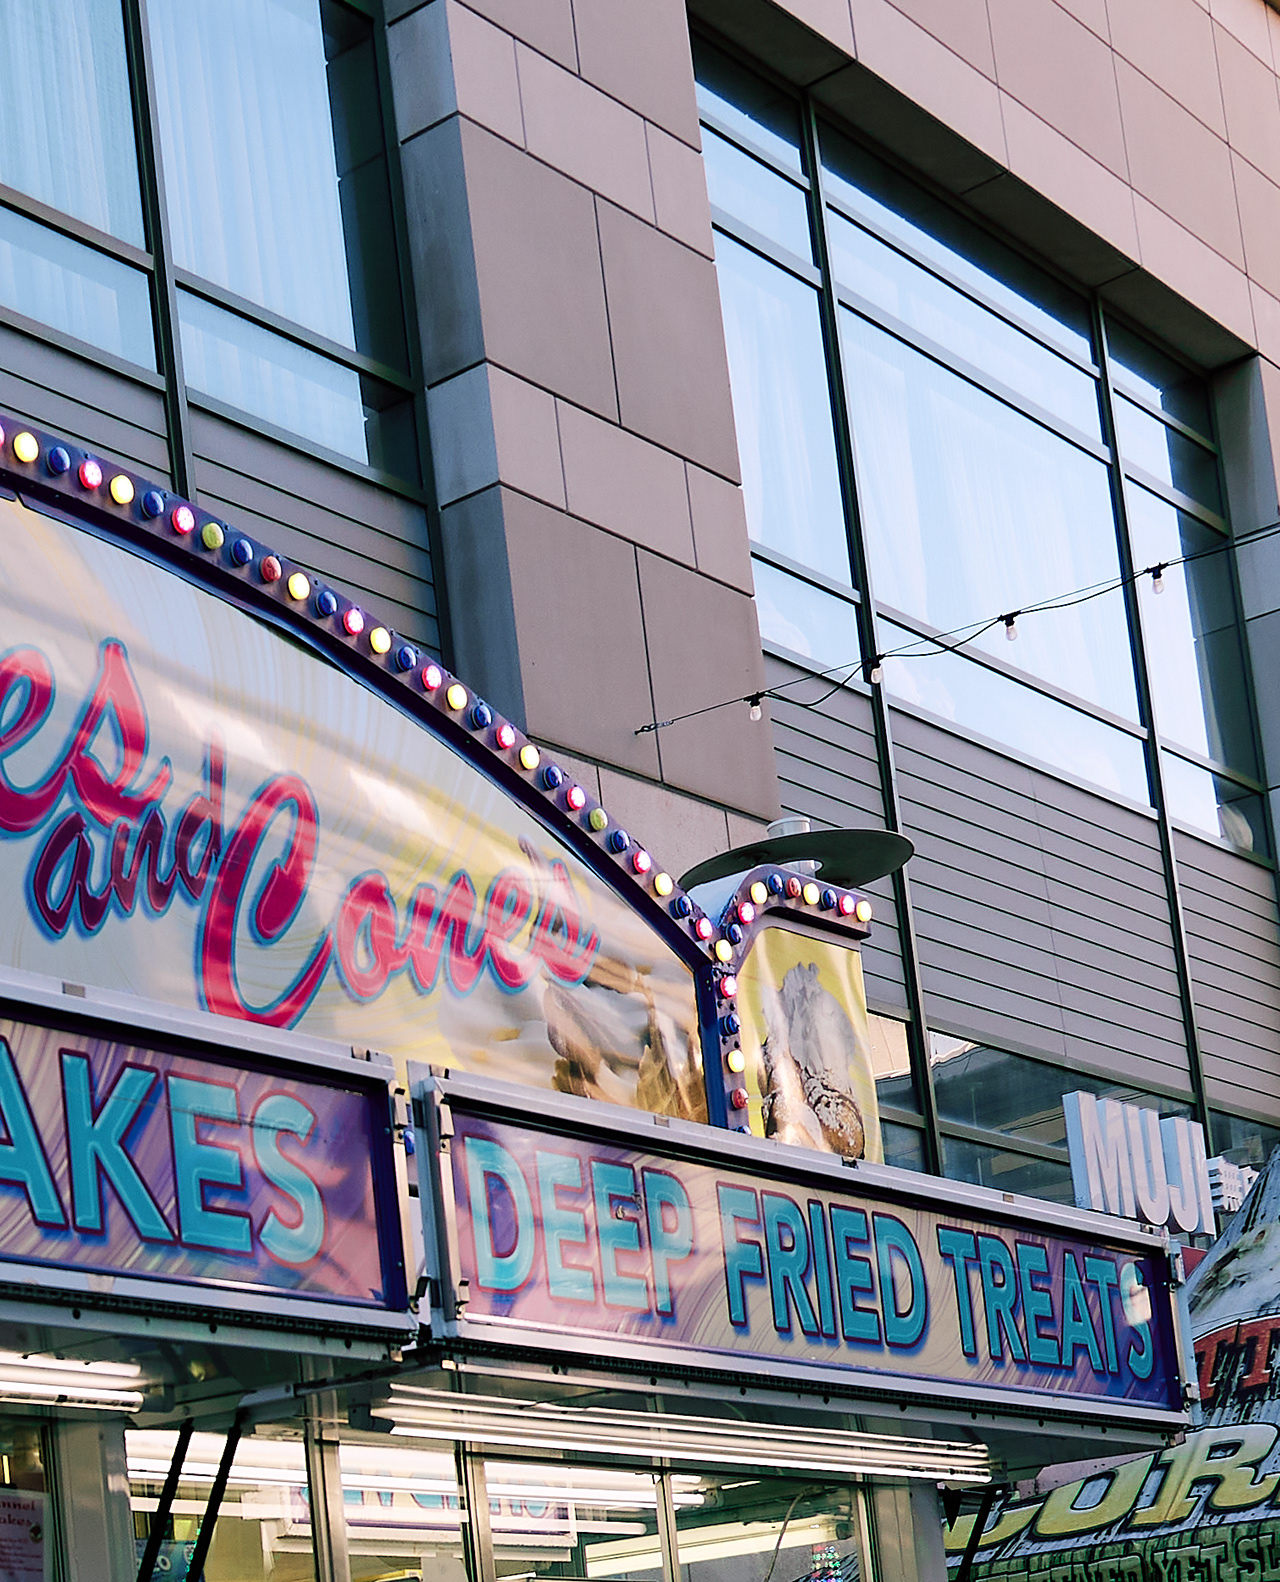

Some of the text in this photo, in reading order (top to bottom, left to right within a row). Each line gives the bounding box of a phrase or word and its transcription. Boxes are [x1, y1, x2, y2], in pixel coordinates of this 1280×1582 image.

[28, 731, 235, 939] and
[193, 769, 602, 1030] Cones
[464, 1133, 1155, 1382] DEEP FRIED TREATS
[1062, 1090, 1216, 1239] MUJI
